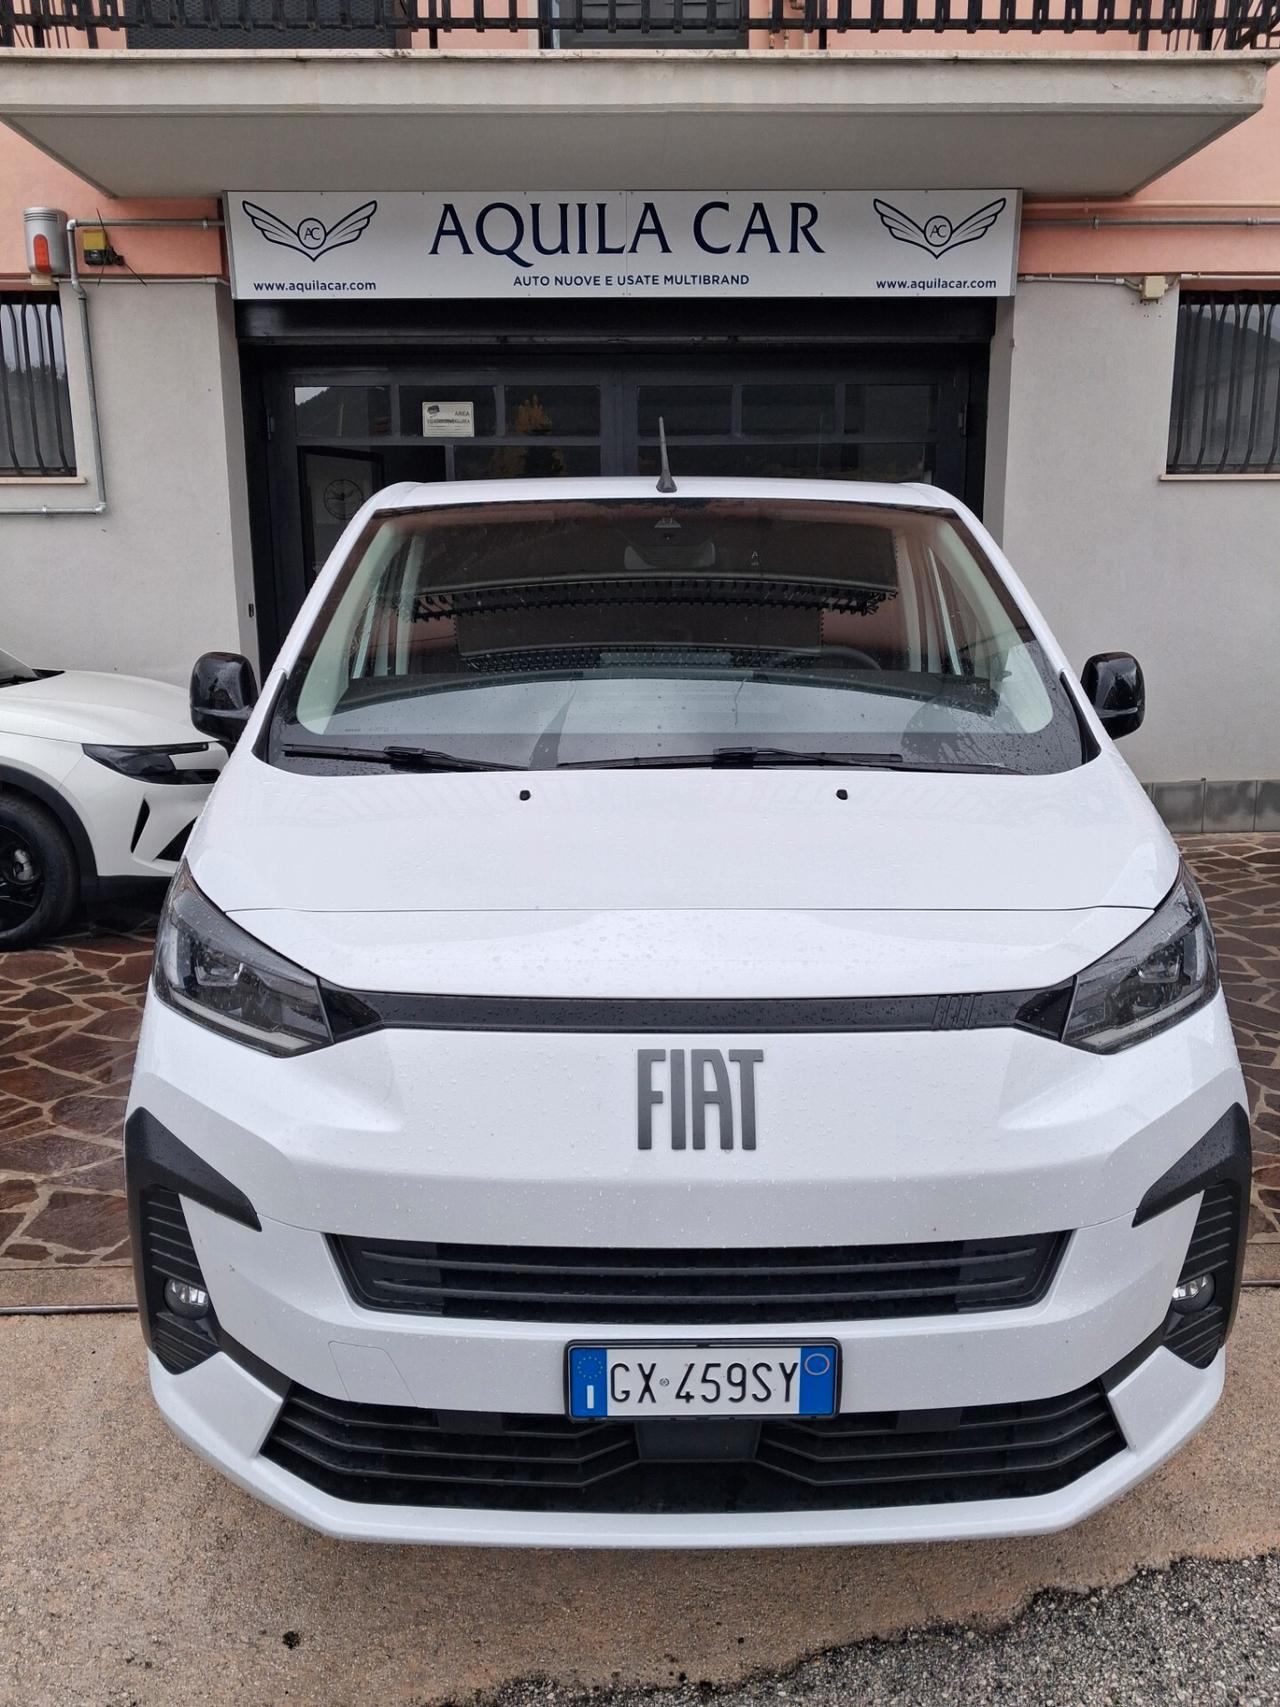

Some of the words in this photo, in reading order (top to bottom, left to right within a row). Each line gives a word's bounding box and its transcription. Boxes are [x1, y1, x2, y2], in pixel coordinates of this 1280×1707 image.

[304, 227, 321, 240] AC
[429, 202, 673, 268] AQUILA
[693, 201, 826, 255] CAR
[930, 224, 947, 239] AC
[253, 279, 377, 293] www.aquilacar.com
[513, 275, 550, 287] AUTO
[554, 275, 601, 287] NUOVE
[605, 275, 613, 286] E
[617, 274, 659, 286] USATE
[663, 274, 750, 286] MULTIBRAND
[876, 277, 998, 291] www.aquilacar.com
[637, 1049, 764, 1151] FIAT
[610, 1362, 657, 1404] GX
[675, 1362, 799, 1404] 459SY
